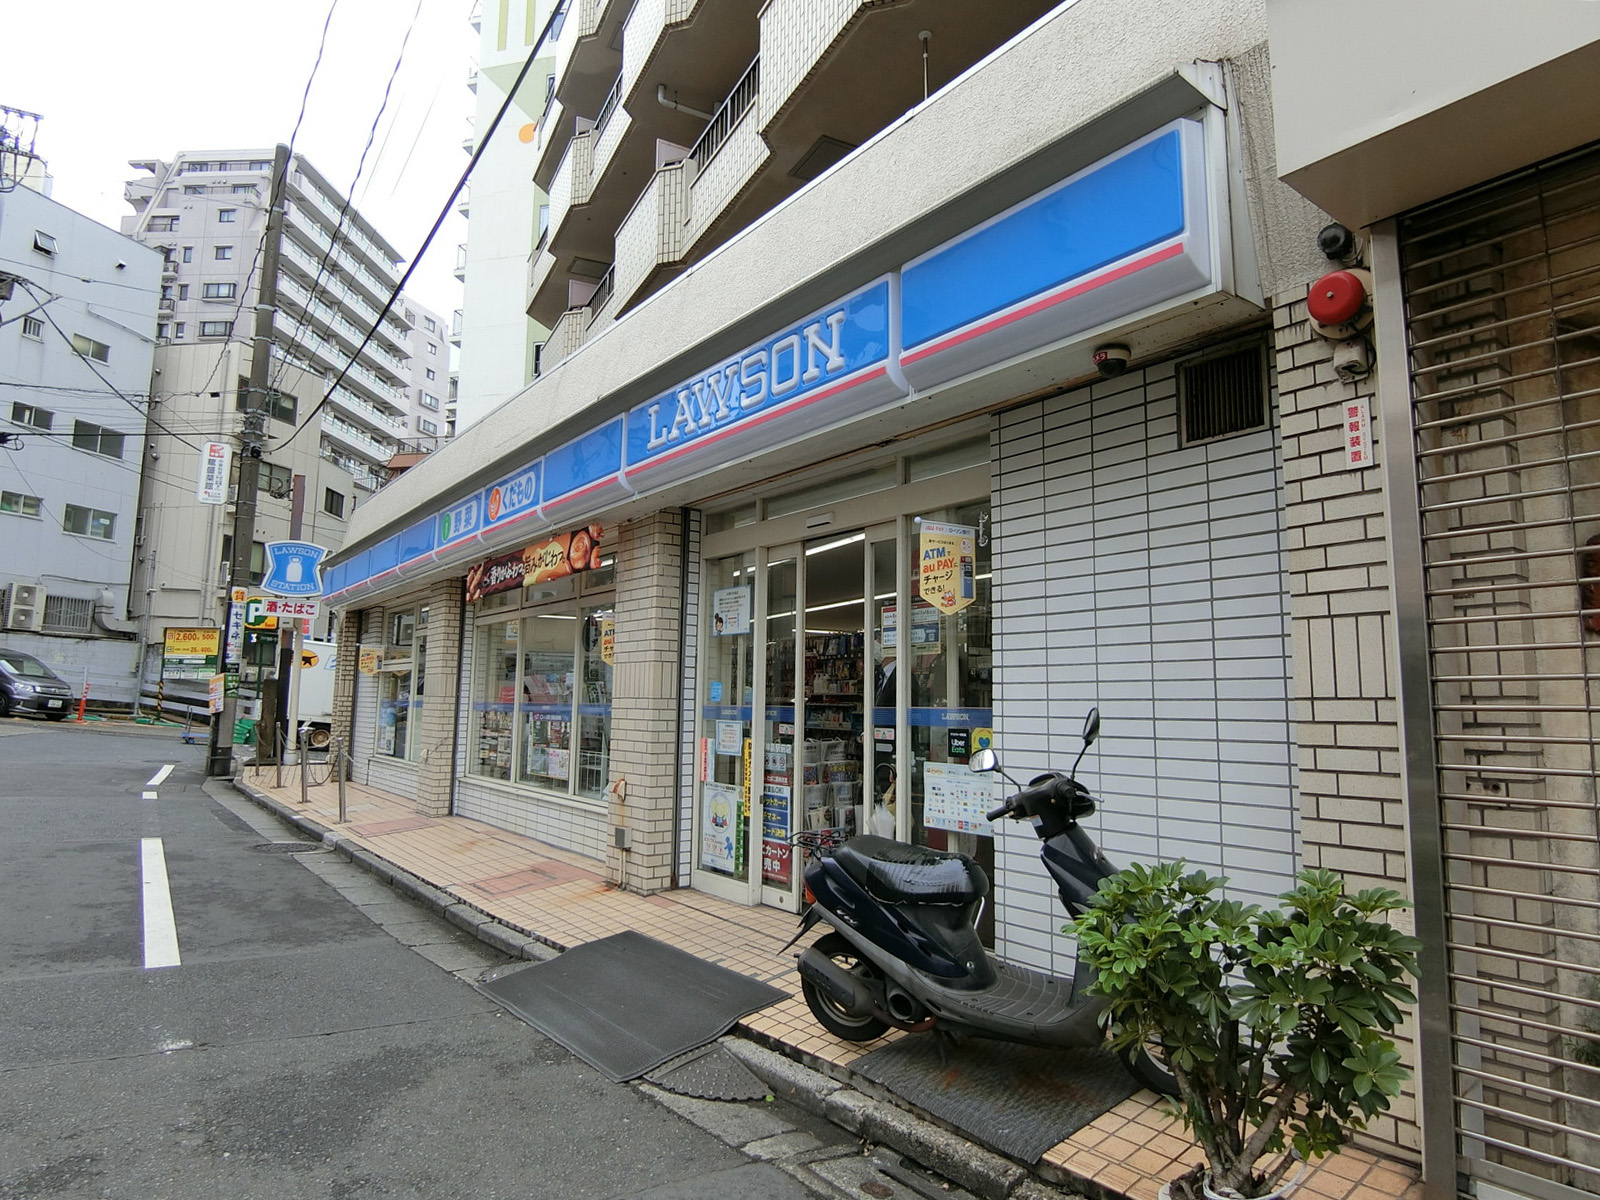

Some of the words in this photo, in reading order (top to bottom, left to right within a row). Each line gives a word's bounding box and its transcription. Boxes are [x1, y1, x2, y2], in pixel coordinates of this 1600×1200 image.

[647, 311, 845, 450] LAWSON
[1347, 406, 1362, 462] 警報装置
[502, 477, 533, 511] くだもの
[453, 504, 473, 533] 野菜
[274, 547, 319, 559] LAWSON
[922, 564, 935, 574] au
[923, 570, 953, 585] チャージ
[271, 579, 315, 591] STATION
[248, 603, 262, 623] P
[231, 611, 243, 640] セキネ
[951, 739, 965, 747] Uber
[952, 746, 965, 754] Eats
